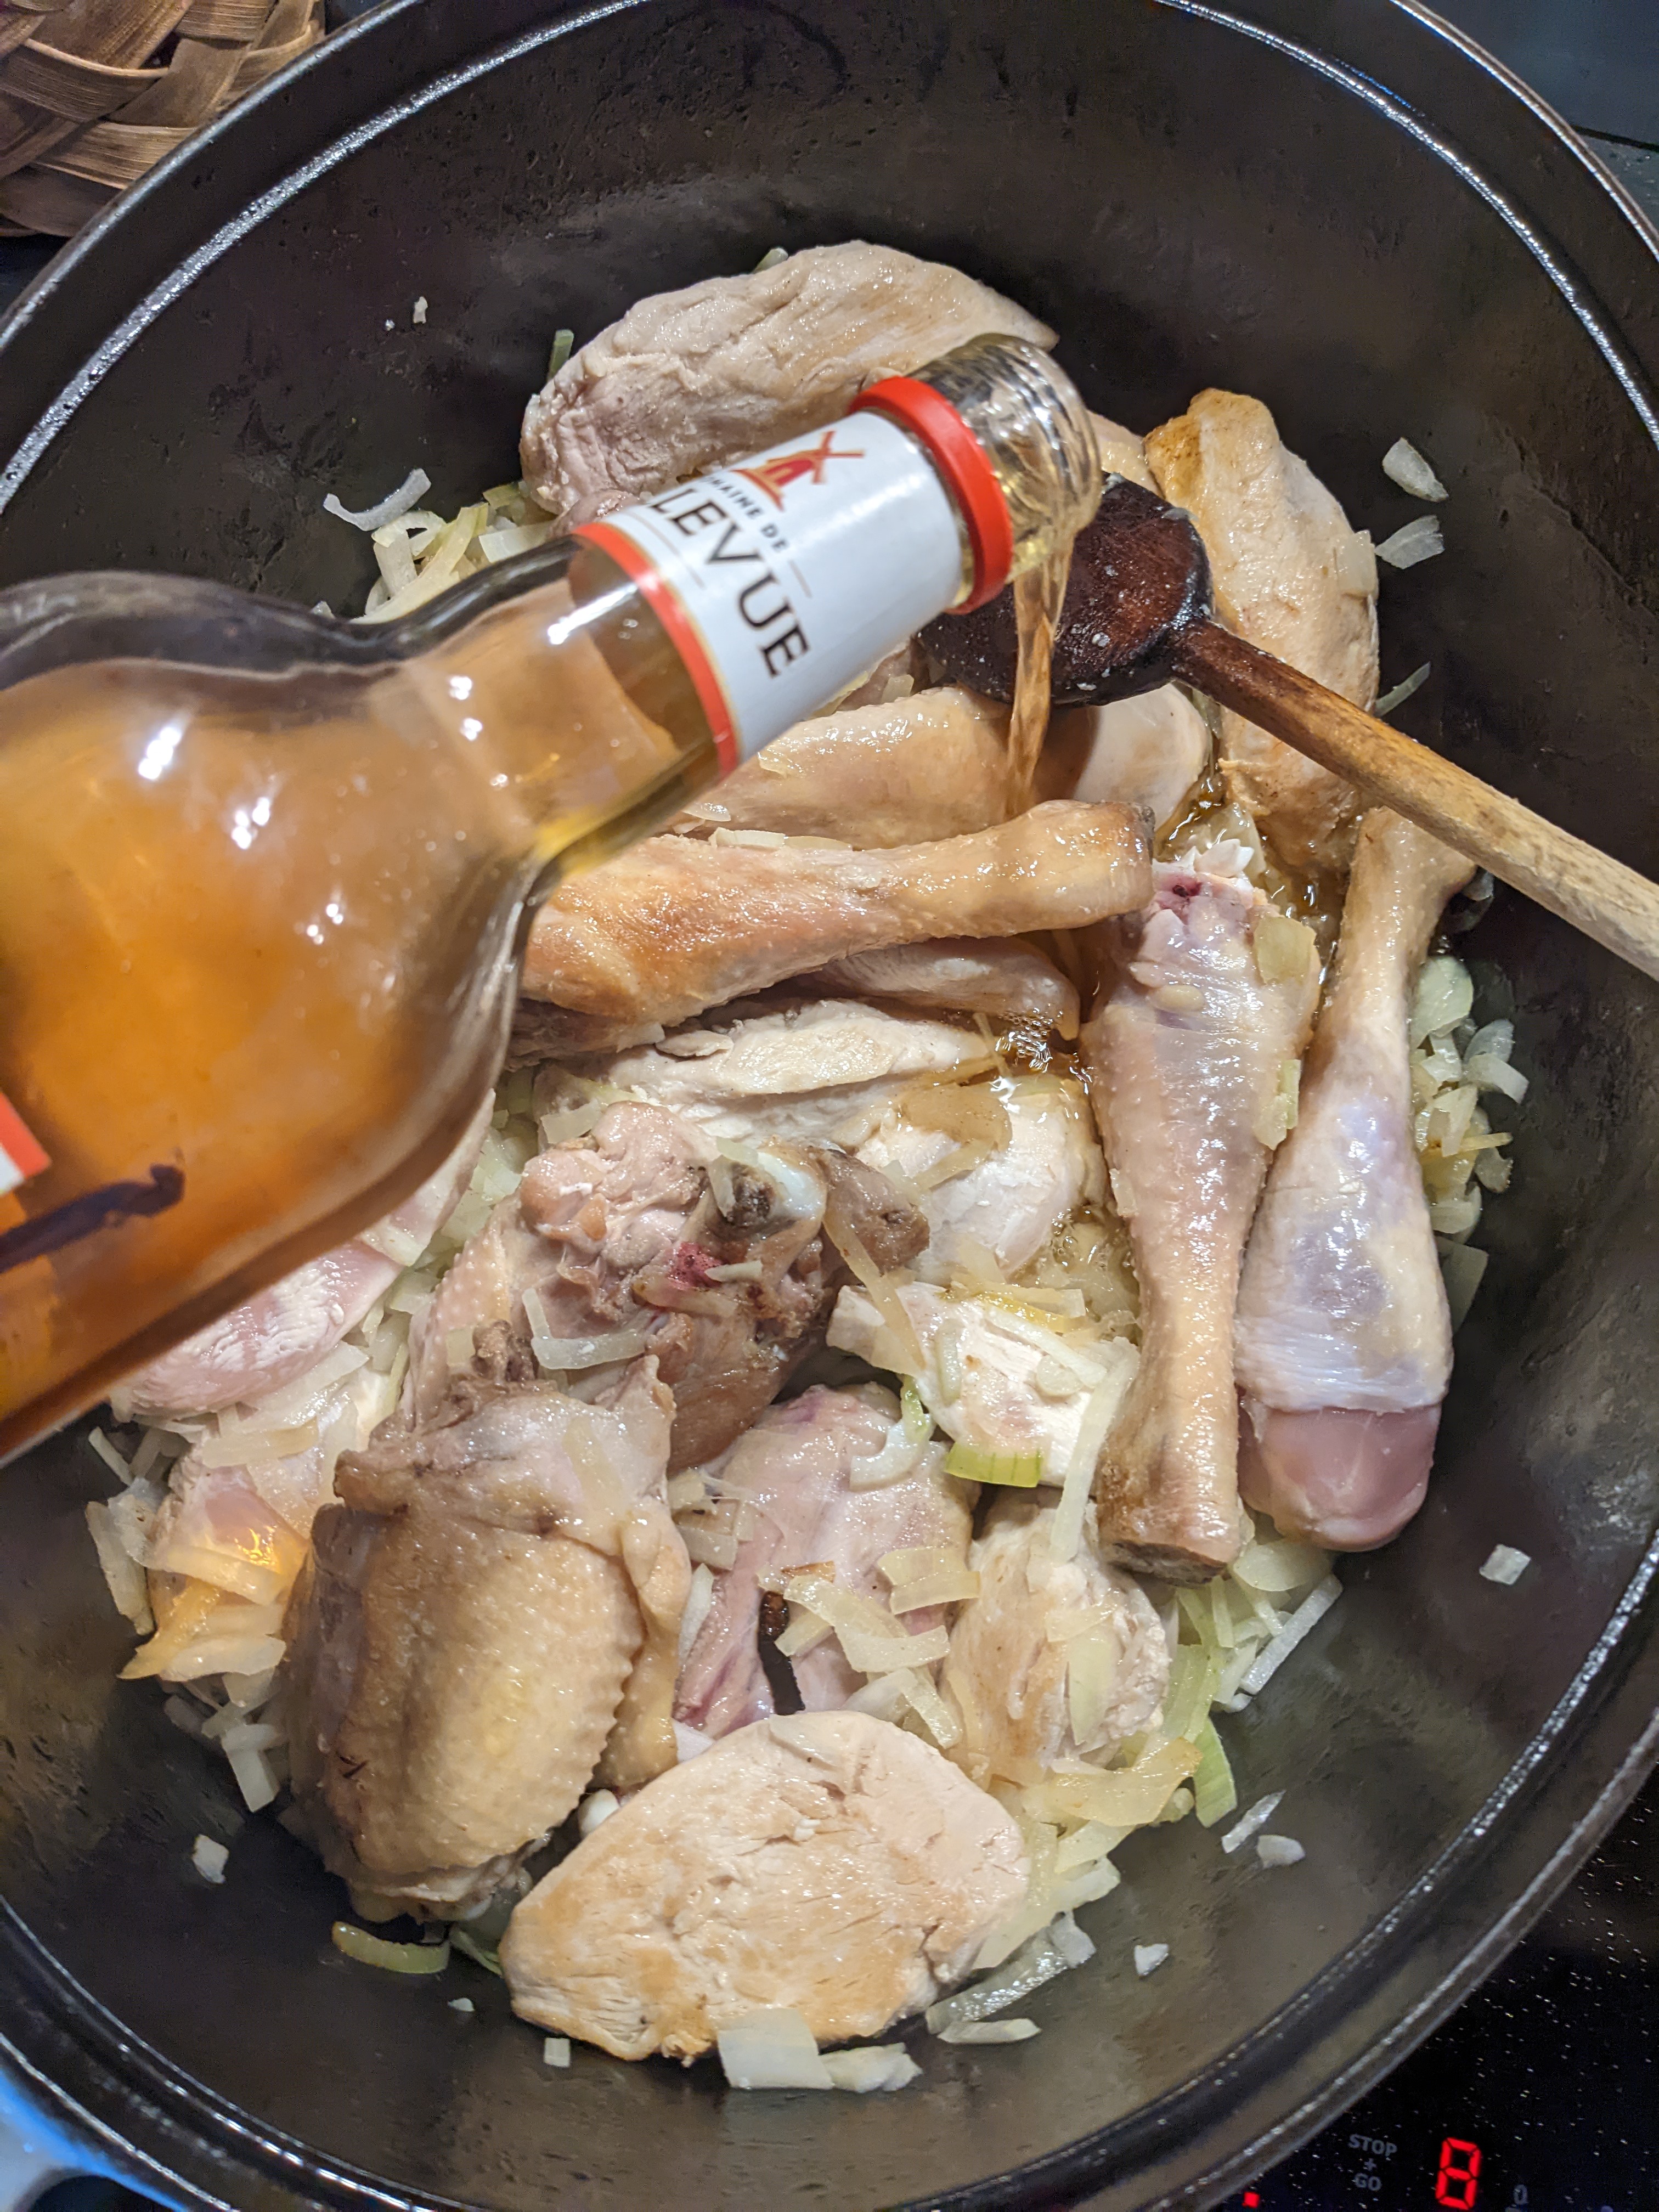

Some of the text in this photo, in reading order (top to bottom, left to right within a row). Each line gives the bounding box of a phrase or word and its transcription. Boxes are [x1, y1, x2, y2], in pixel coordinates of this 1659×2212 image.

[760, 523, 789, 552] DE
[650, 488, 810, 678] LEVUE
[1348, 2134, 1398, 2157] STOP
[1353, 2172, 1383, 2191] GO
[1435, 2137, 1481, 2210] 8
